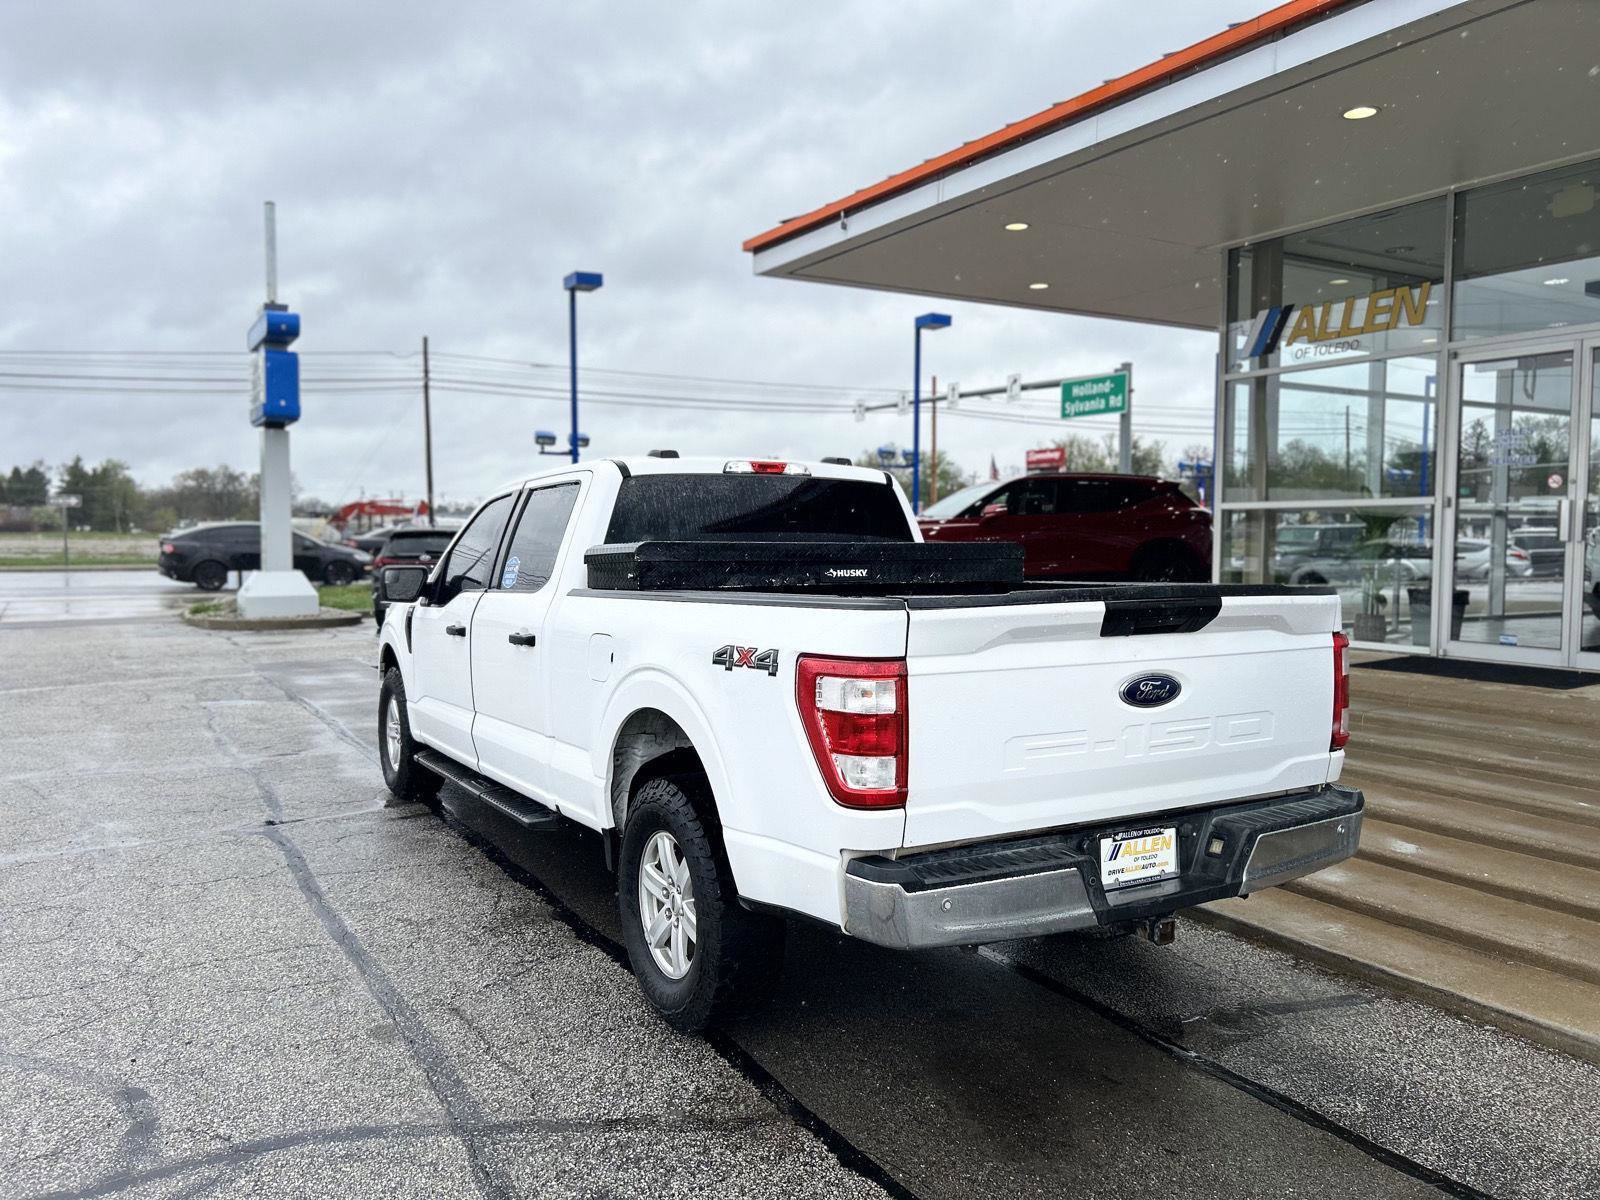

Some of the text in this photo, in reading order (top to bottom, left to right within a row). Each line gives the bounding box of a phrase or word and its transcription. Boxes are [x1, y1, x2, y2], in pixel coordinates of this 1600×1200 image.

[1286, 282, 1431, 346] ALLEN
[1295, 339, 1360, 360] OF TOLEDO
[1072, 379, 1115, 397] Holland-
[1065, 394, 1122, 416] Sylvania Rd
[836, 569, 868, 577] HUSKY
[1136, 681, 1170, 700] Ford
[1002, 710, 1275, 772] F-150
[1120, 831, 1137, 839] ALLEN
[1143, 828, 1161, 836] TOLEDO
[1120, 835, 1173, 857] ALLEN
